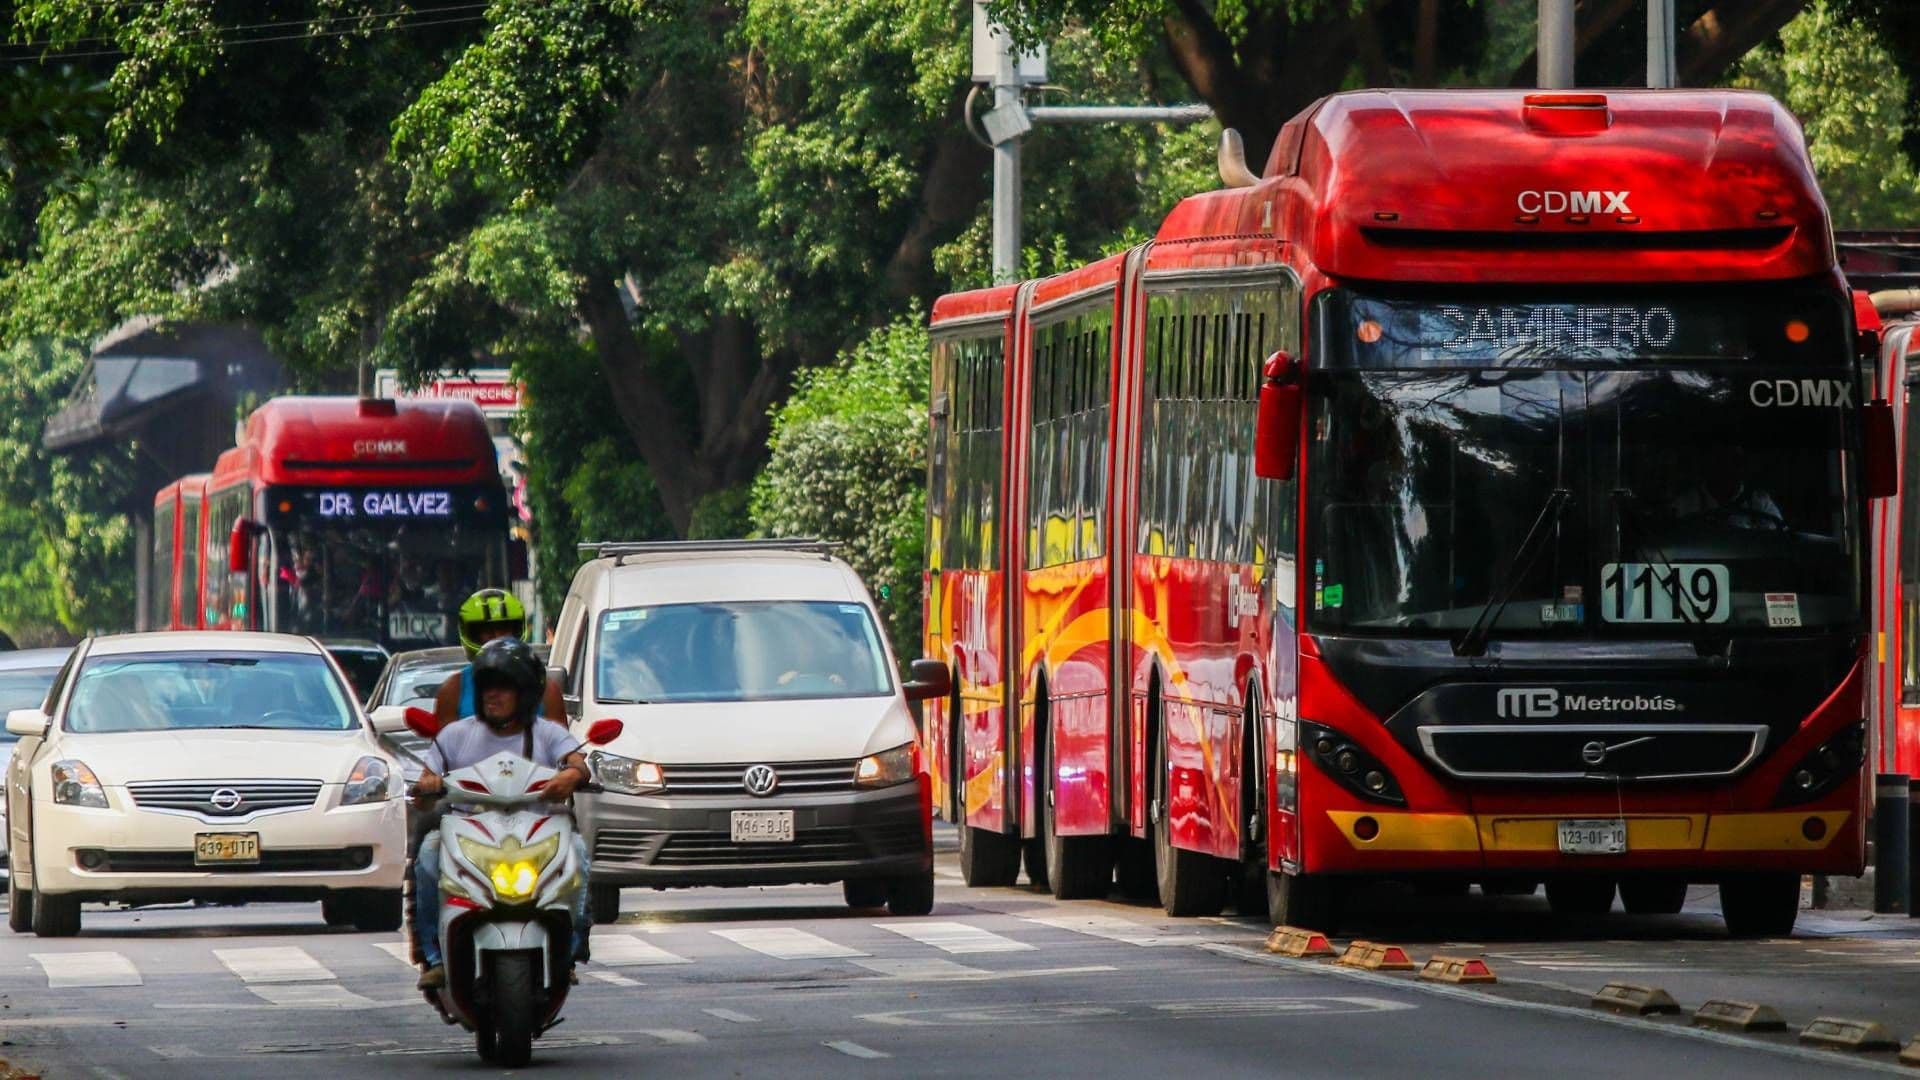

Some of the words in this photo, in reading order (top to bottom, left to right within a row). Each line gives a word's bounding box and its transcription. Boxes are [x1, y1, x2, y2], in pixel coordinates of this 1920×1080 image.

[1517, 190, 1633, 214] CDMX
[1749, 379, 1854, 408] CDMX
[353, 440, 406, 453] CDMX
[319, 493, 355, 515] DR.
[362, 492, 450, 515] GALVEZ
[1604, 567, 1719, 622] 1119
[1564, 695, 1677, 712] Metrobús
[1562, 830, 1625, 845] 123-01-10
[199, 840, 255, 856] 439-UTP
